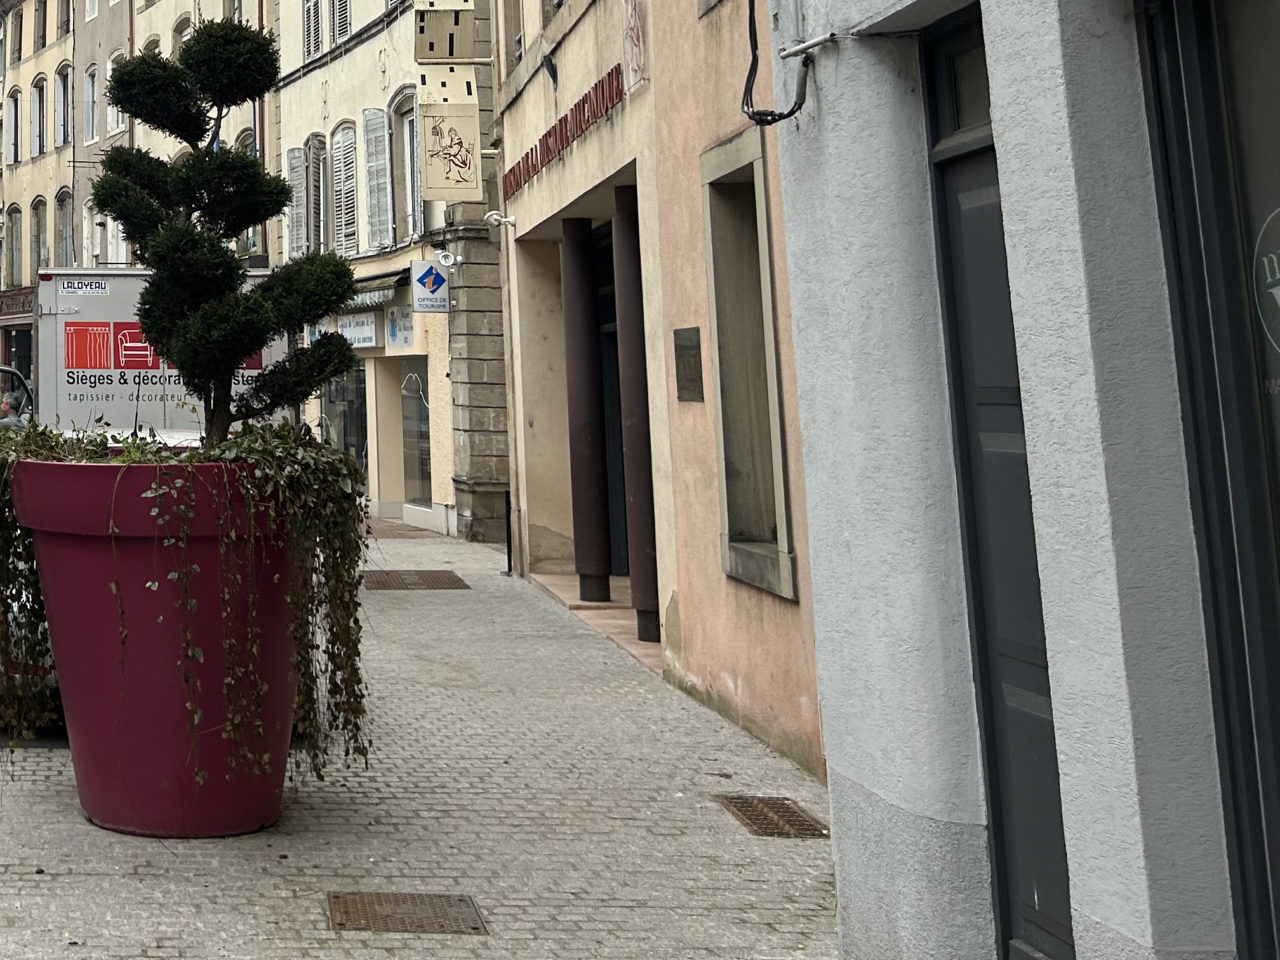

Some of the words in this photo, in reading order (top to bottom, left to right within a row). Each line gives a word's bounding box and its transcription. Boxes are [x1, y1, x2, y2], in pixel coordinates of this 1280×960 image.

[538, 113, 570, 170] MUSIQUE
[62, 281, 107, 290] LALOYEAU
[66, 370, 114, 389] Sièges
[118, 370, 129, 385] &
[68, 392, 115, 404] tapissier
